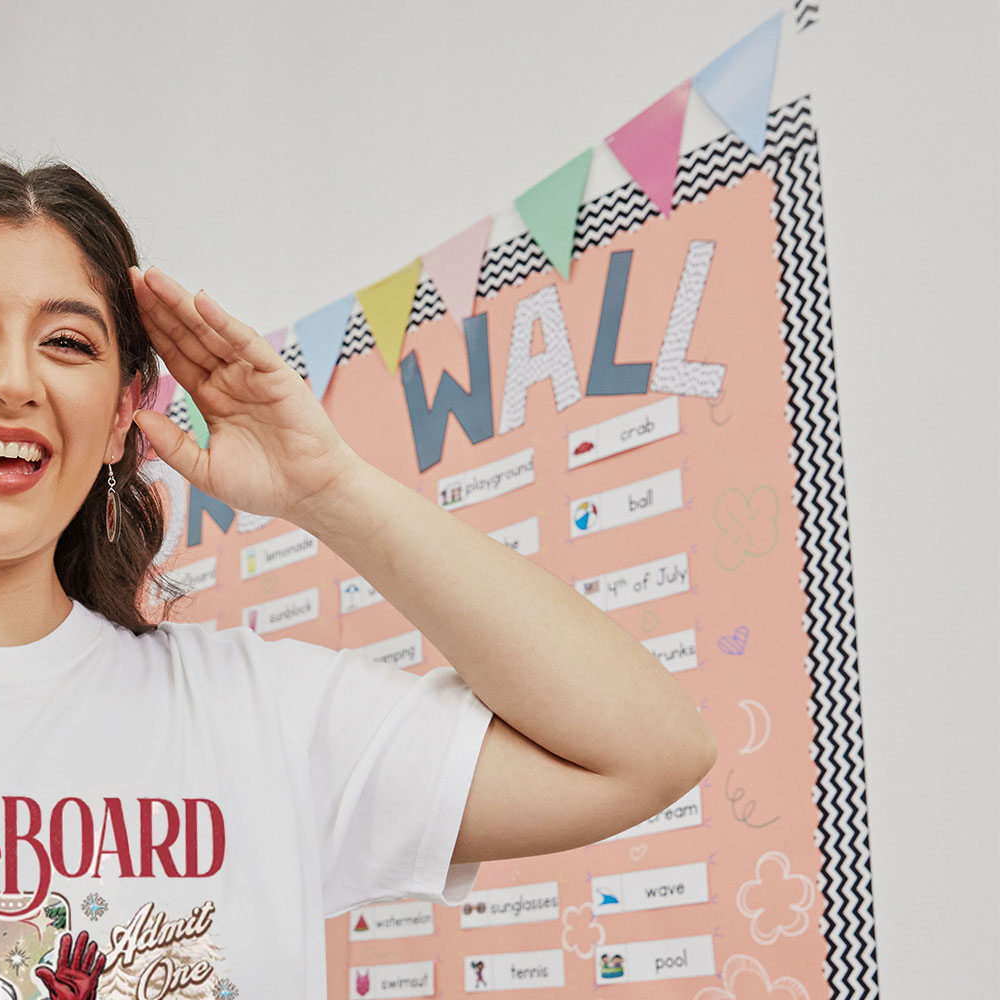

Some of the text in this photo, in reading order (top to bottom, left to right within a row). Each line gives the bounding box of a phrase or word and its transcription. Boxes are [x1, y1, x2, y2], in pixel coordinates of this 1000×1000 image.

[400, 240, 727, 472] WALL
[620, 417, 655, 441] crab
[628, 488, 653, 512] ball
[634, 572, 650, 593] of
[656, 563, 688, 588] July
[645, 882, 685, 900] wave
[491, 894, 558, 918] sunglasses
[102, 900, 216, 974] Admit
[511, 962, 549, 981] tennis
[655, 948, 688, 975] pool
